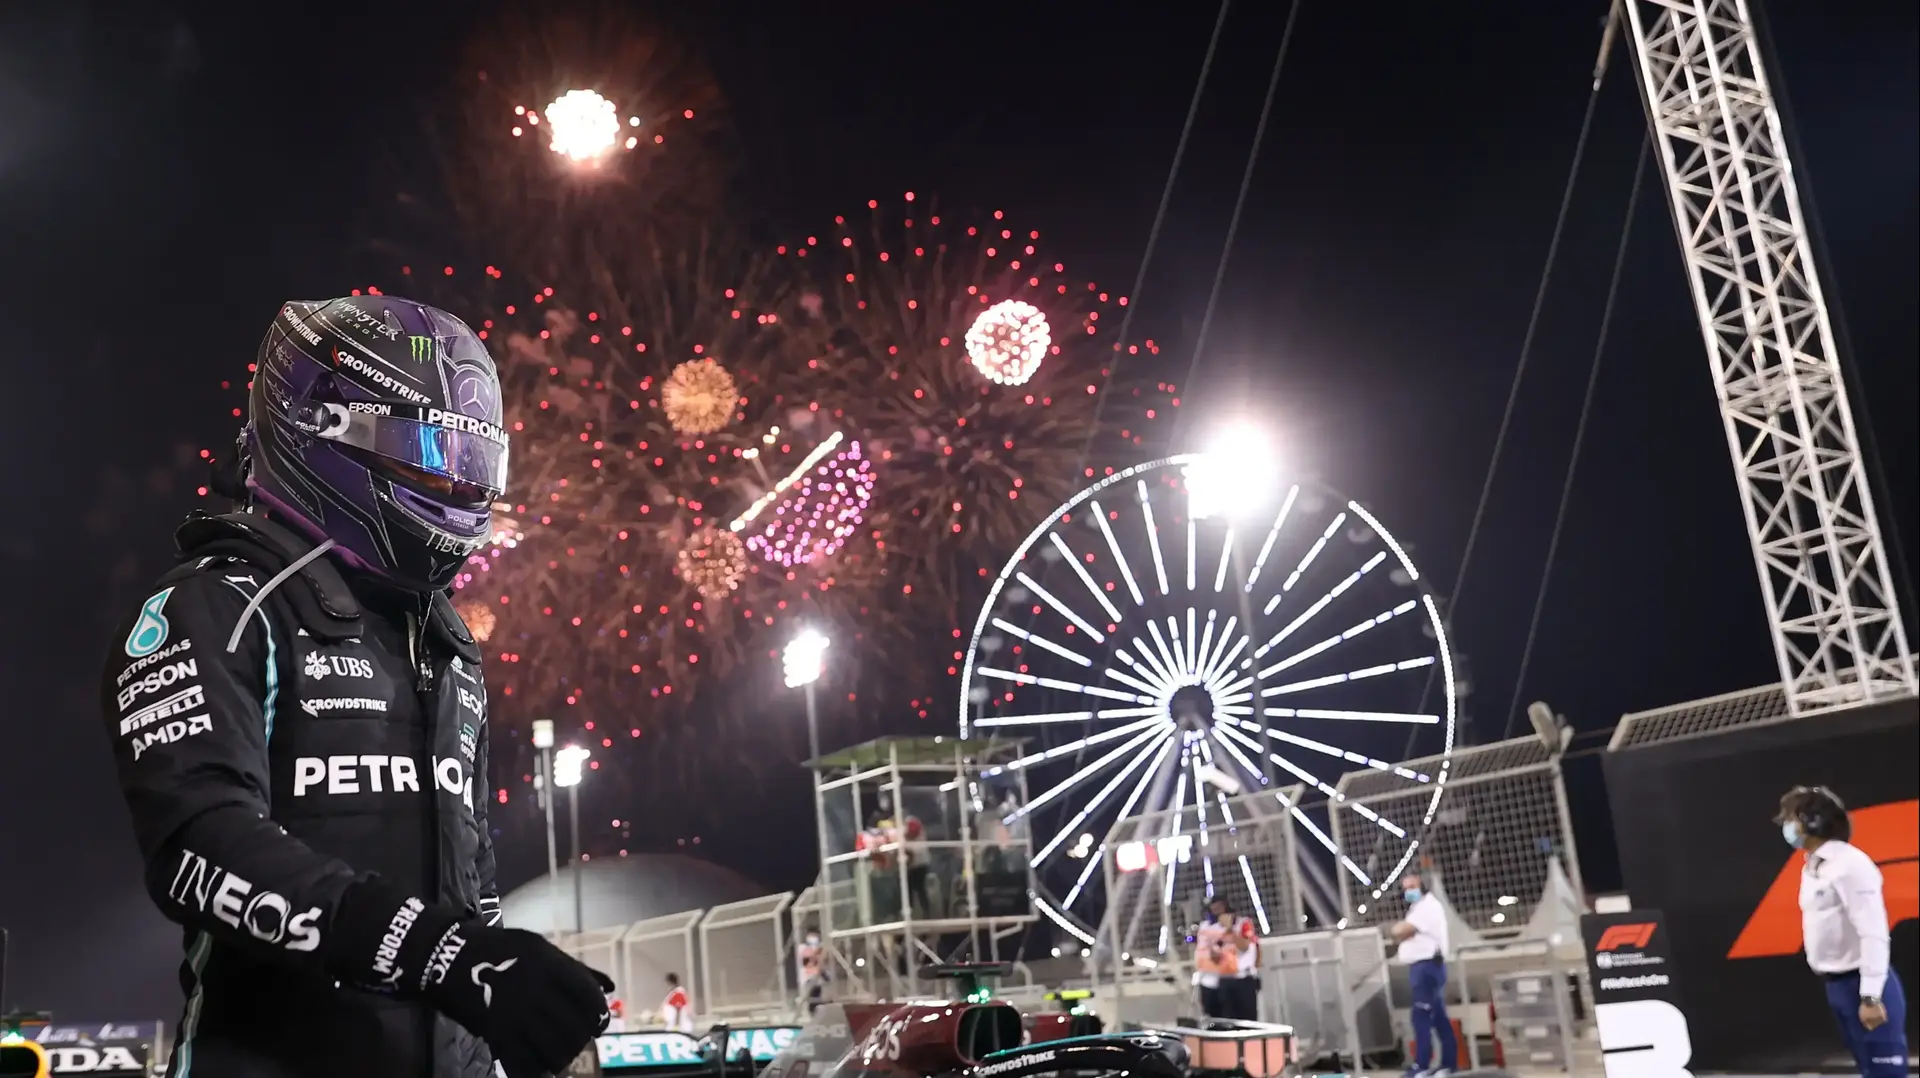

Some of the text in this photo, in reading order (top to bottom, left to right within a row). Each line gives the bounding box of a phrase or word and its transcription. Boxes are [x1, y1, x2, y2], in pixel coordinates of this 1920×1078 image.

[283, 306, 323, 346] CROWDSTRIKE
[332, 310, 379, 340] ENERGY
[338, 351, 432, 404] CROWDSTRIKE
[295, 420, 320, 432] POLICE
[348, 401, 392, 416] EPSON
[428, 408, 508, 446] PETRONA
[447, 514, 476, 526] POLICE
[116, 639, 192, 687] PETRONAS
[330, 656, 374, 679] UBS
[117, 658, 198, 712] EPSON
[307, 698, 387, 712] CROWDSTRIKE
[120, 685, 205, 736] PIRELLI
[132, 720, 187, 760] AMD
[168, 848, 322, 952] INEOS
[372, 897, 425, 974] #REFORM
[429, 934, 467, 985] IWC
[978, 1050, 1056, 1077] CROWDSTRIKE
